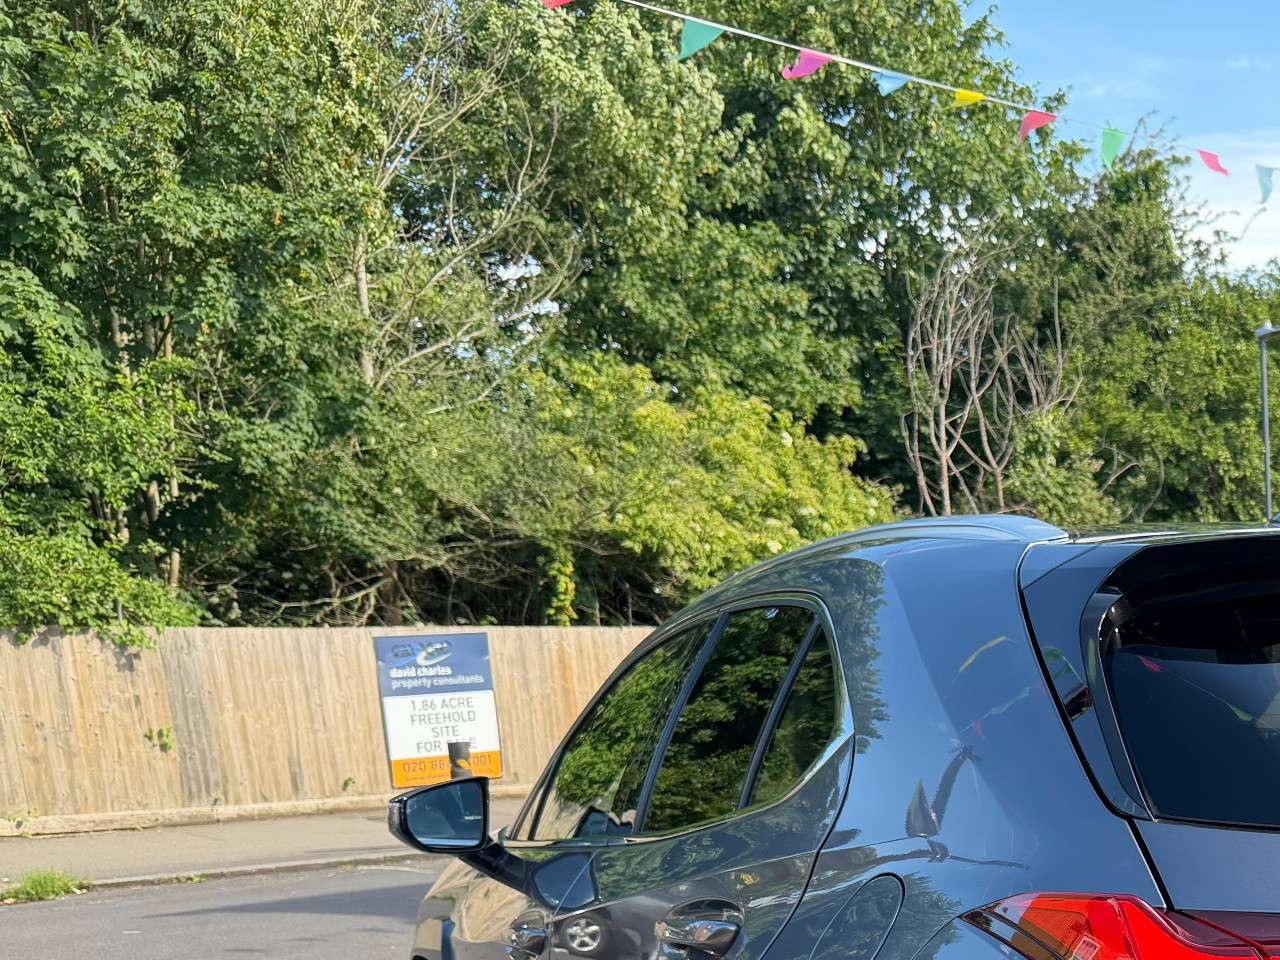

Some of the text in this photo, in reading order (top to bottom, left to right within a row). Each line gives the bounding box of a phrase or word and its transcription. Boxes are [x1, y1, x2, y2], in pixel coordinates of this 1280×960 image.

[411, 696, 474, 712] 1.86 ACRE
[410, 710, 477, 726] FREEHOLD
[431, 725, 460, 739] SITE
[416, 741, 442, 754] FOR
